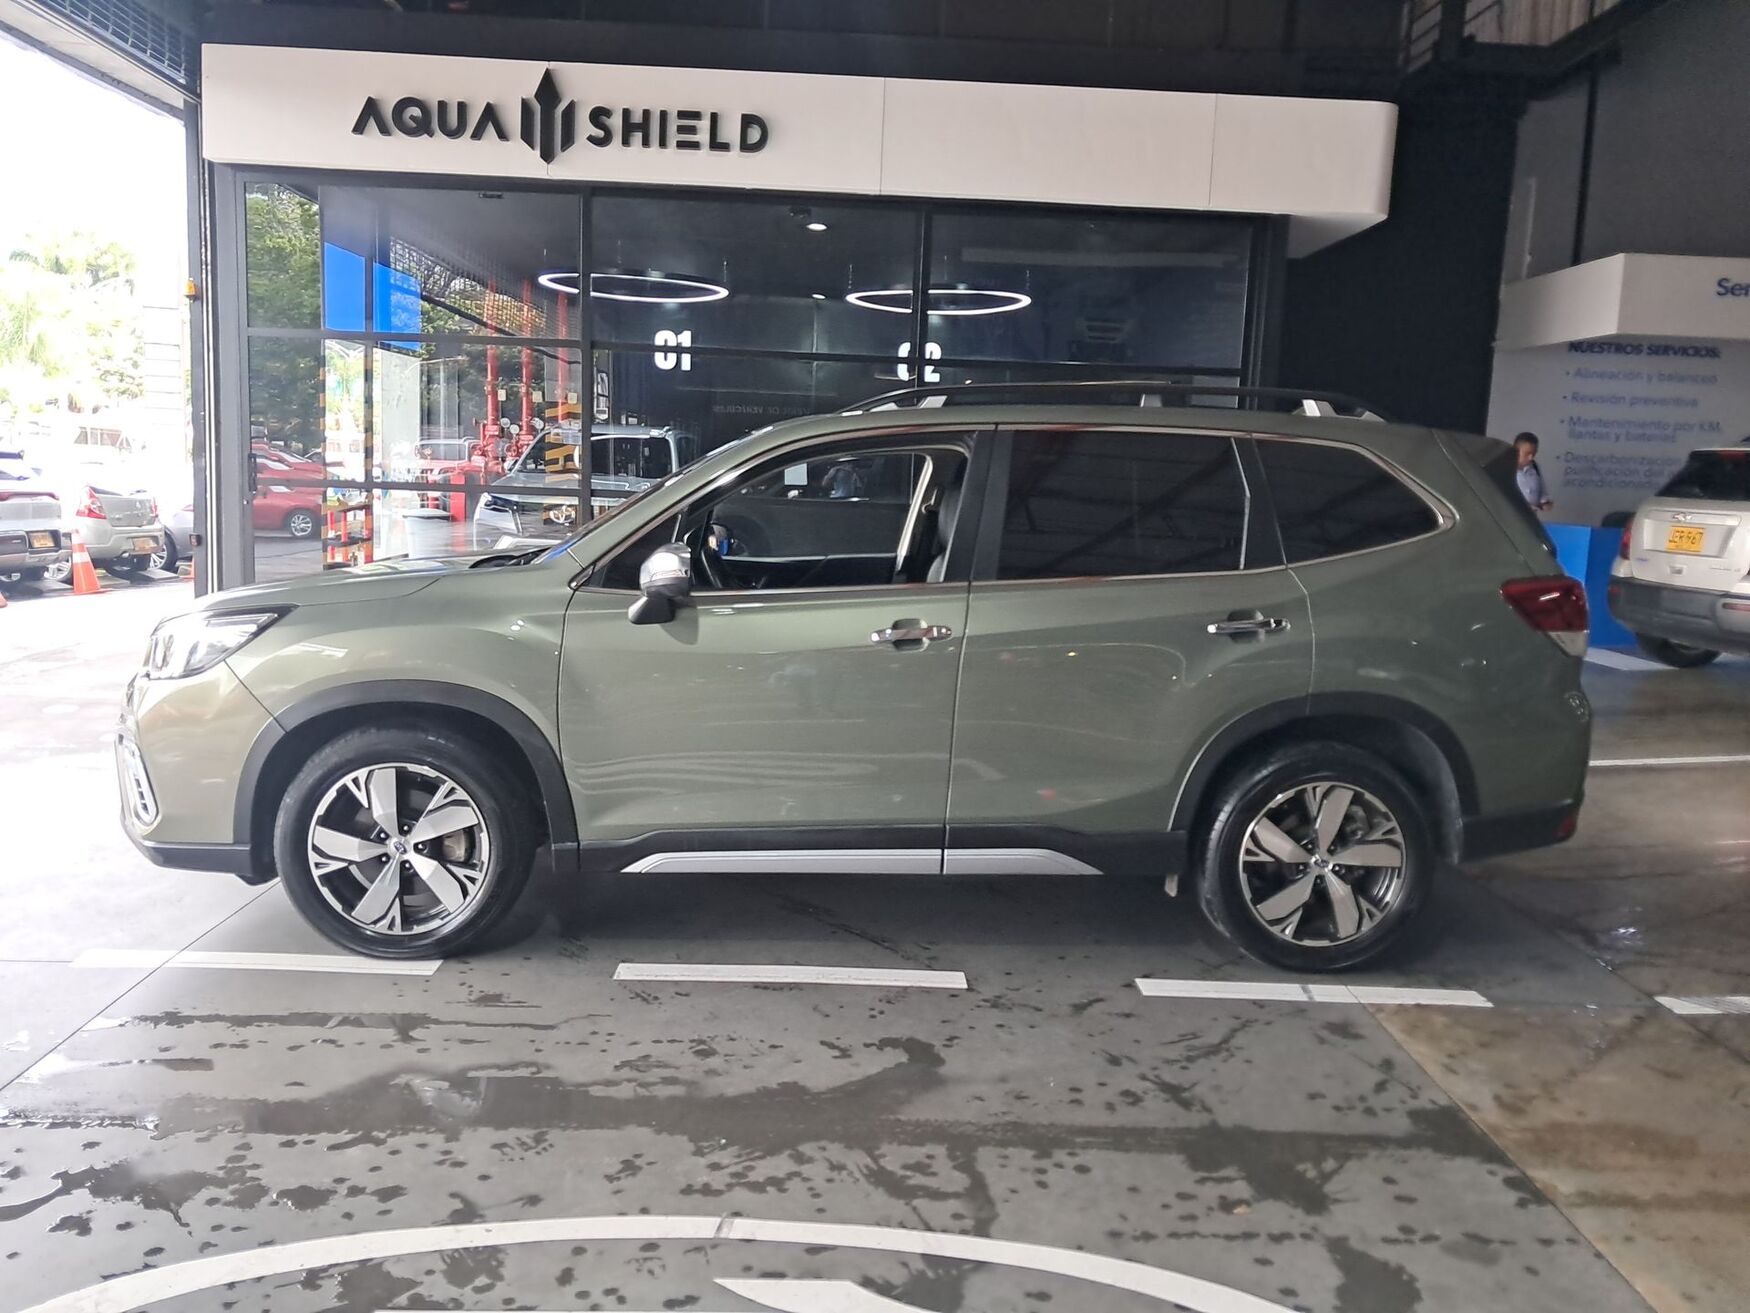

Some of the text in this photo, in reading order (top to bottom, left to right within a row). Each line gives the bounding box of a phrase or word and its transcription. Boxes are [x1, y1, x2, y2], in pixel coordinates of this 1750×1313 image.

[351, 95, 769, 154] AQUA SHIELD
[654, 330, 692, 371] 01
[1567, 341, 1644, 355] NUESTROS
